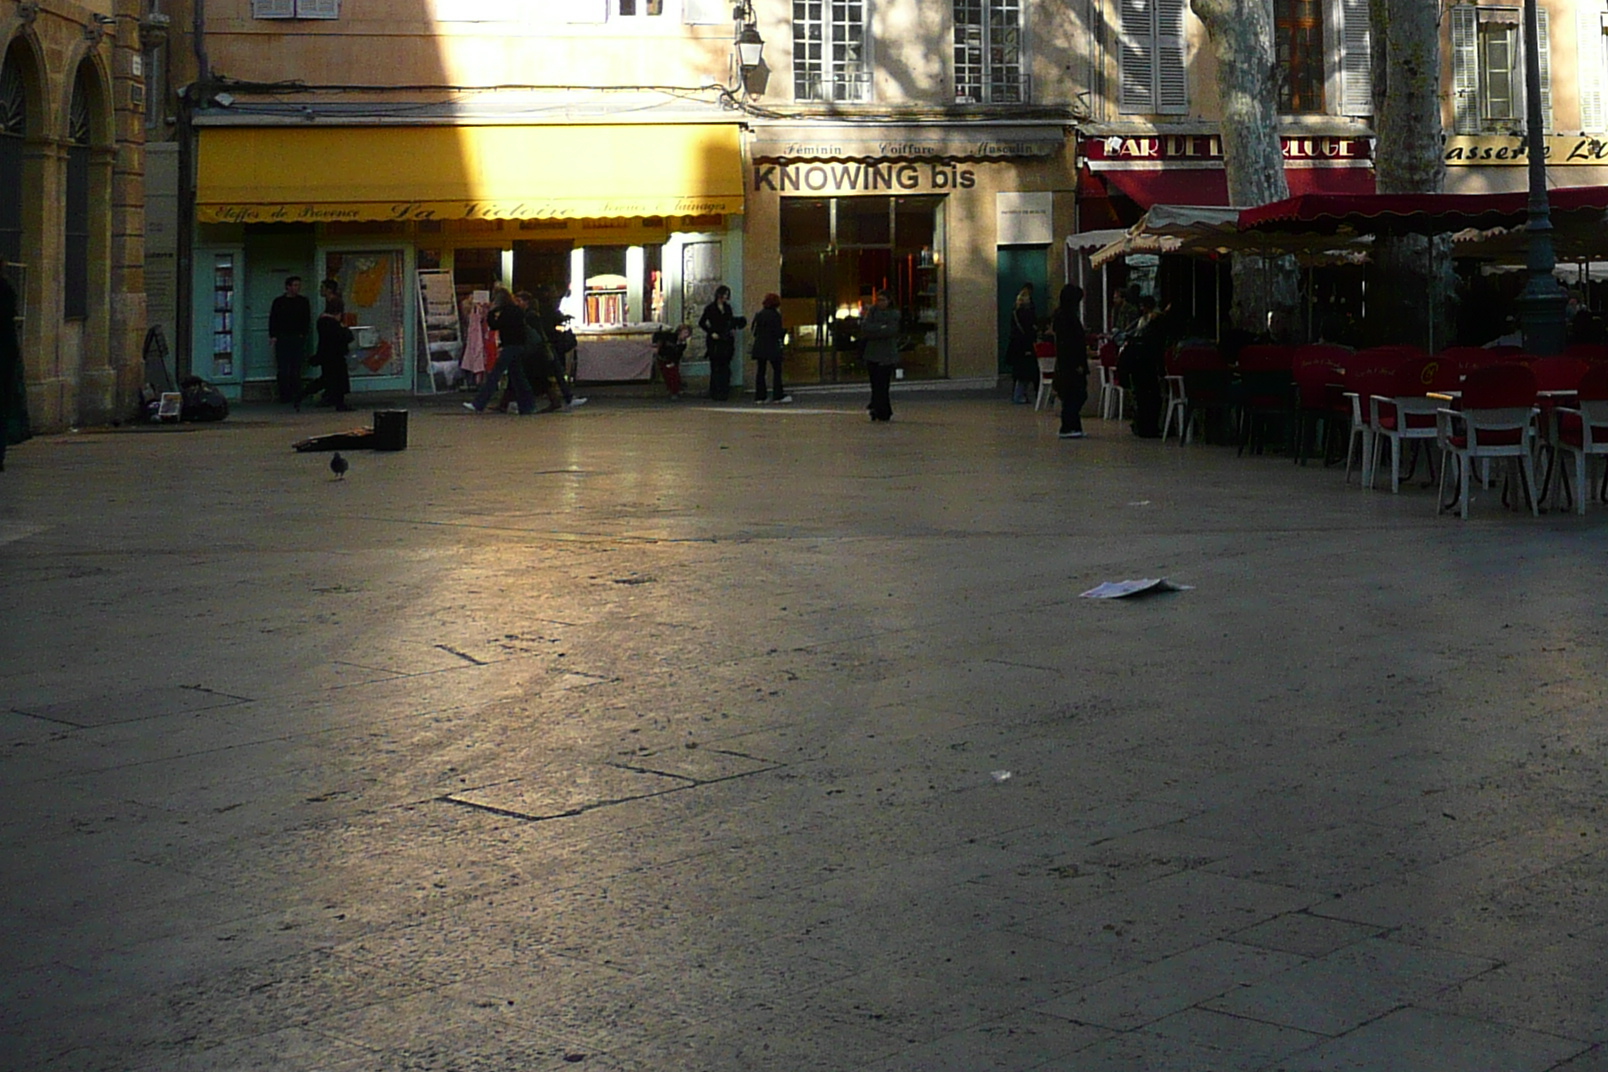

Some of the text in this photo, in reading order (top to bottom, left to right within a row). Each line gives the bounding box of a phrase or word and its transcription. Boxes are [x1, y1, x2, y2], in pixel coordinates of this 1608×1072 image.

[785, 142, 1032, 155] Féminin Coiffure Masculin
[1104, 135, 1157, 156] BAR
[1167, 134, 1201, 156] DE
[754, 164, 975, 191] KNOWING bis
[271, 205, 287, 218] de
[298, 205, 360, 218] Provence
[391, 203, 435, 218] La
[464, 202, 575, 217] Victoire
